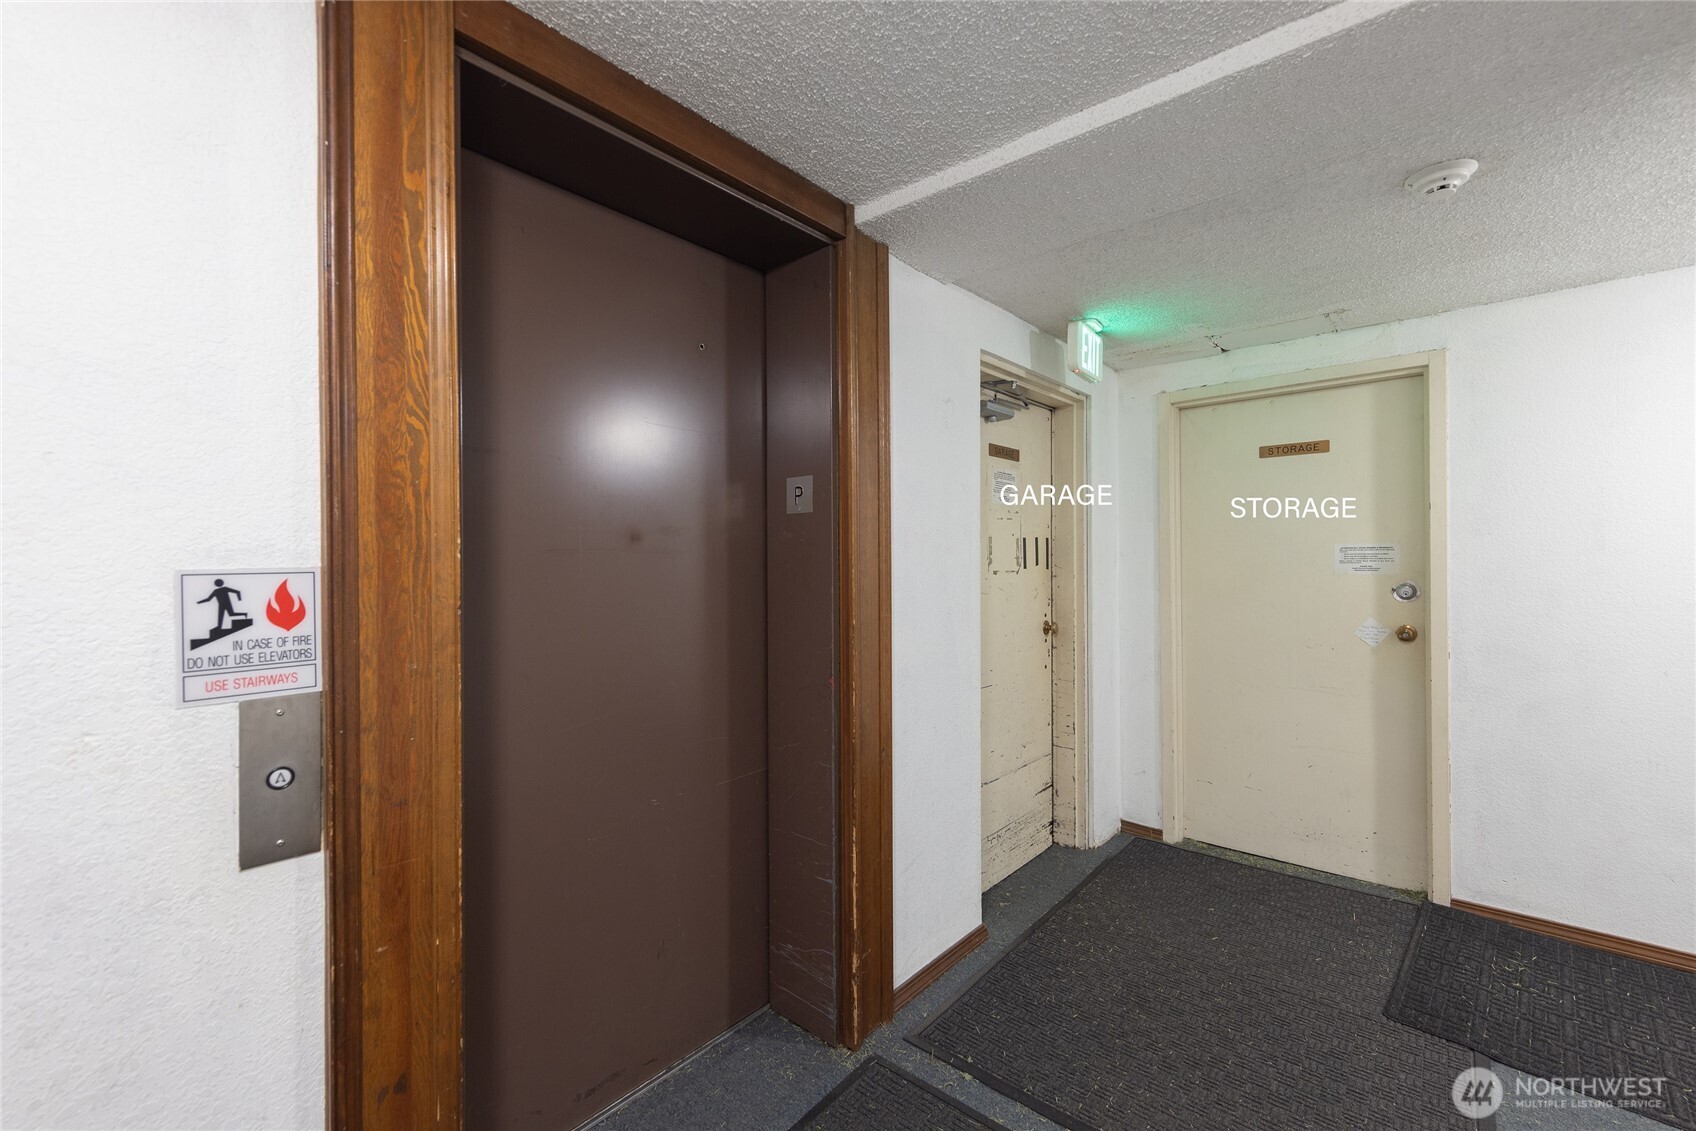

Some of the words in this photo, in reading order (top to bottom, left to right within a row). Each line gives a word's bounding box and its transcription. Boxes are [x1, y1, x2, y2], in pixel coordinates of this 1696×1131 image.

[1081, 326, 1101, 377] EXIT
[1267, 442, 1321, 456] STORAGE
[794, 486, 804, 505] P
[232, 640, 243, 651] IN
[246, 638, 273, 651] CASE
[277, 637, 289, 648] OF
[292, 634, 312, 646] FIRE
[187, 657, 204, 670] DO
[207, 655, 230, 668] NOT
[234, 653, 254, 665] USE
[259, 648, 313, 662] ELEVATORS
[205, 679, 229, 693] USE
[233, 672, 298, 690] STAIRWAYS
